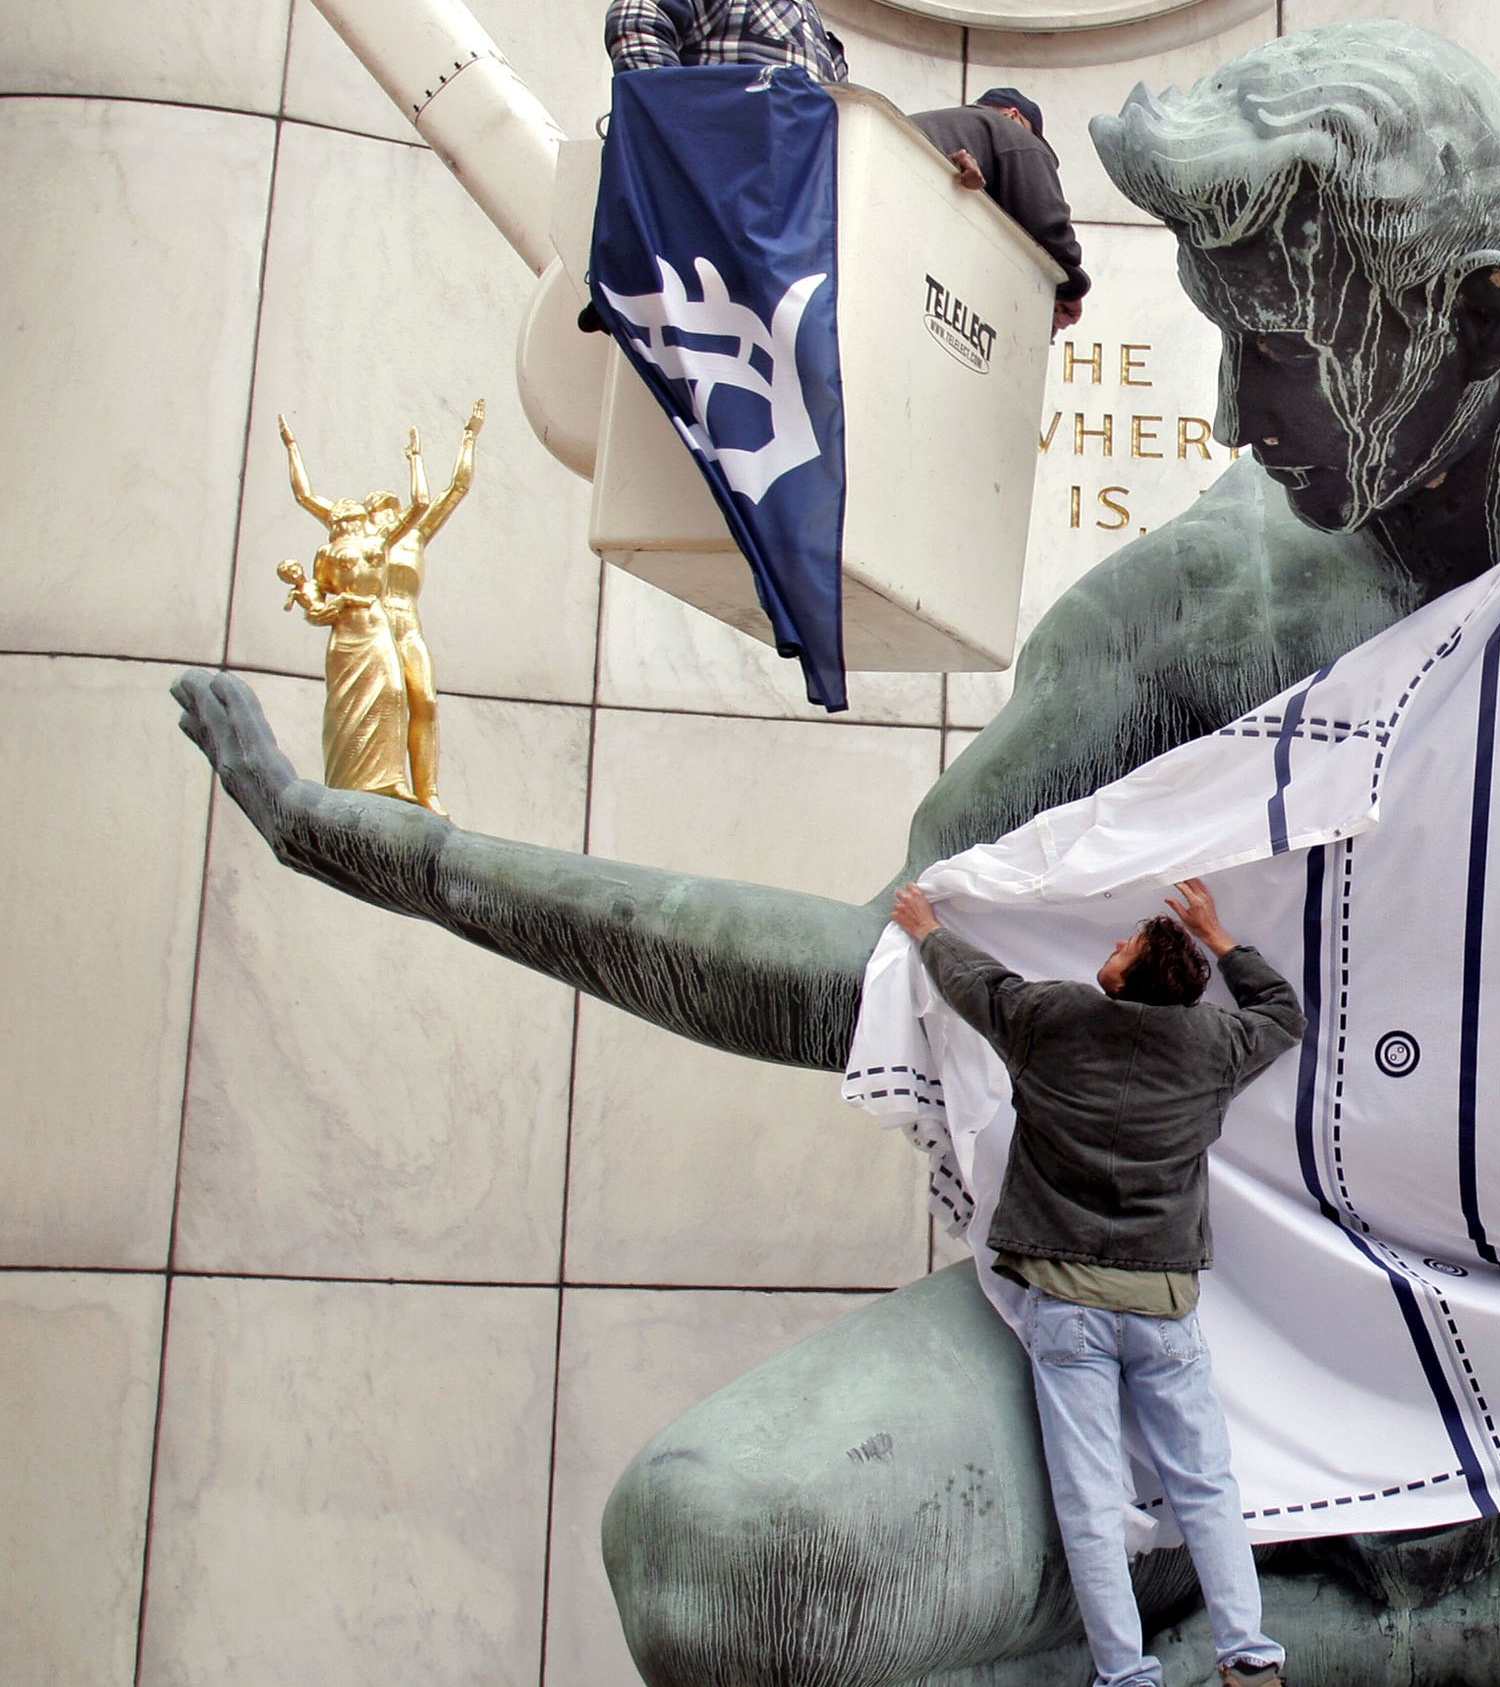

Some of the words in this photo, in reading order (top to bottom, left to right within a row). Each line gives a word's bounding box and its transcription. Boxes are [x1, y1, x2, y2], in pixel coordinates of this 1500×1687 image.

[925, 272, 997, 361] TELELECT
[1063, 341, 1153, 387] HE
[1038, 411, 1241, 460] HER
